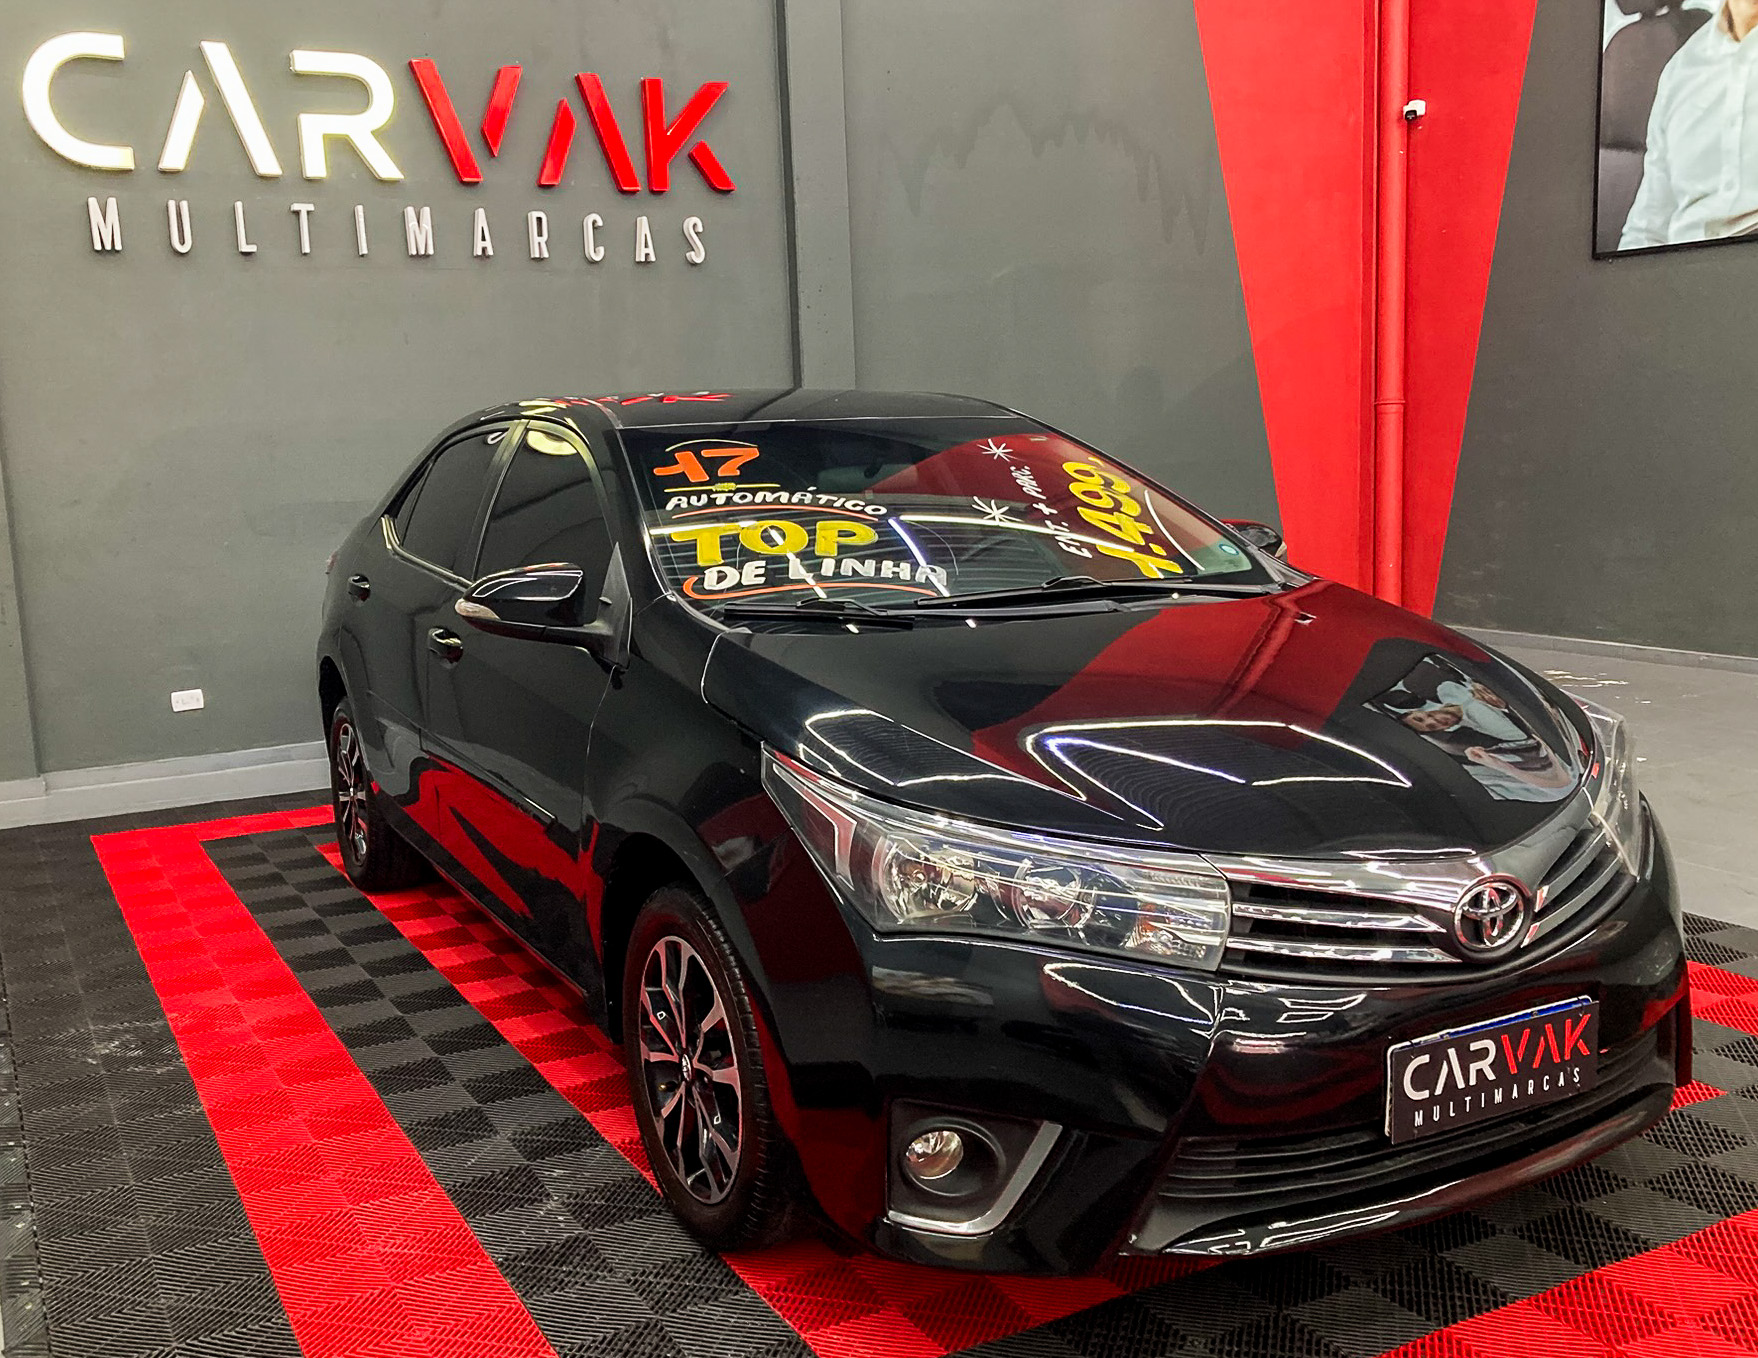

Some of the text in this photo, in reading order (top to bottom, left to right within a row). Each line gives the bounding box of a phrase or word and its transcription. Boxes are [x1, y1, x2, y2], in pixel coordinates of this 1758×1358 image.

[22, 31, 736, 193] CARVAK
[87, 197, 707, 265] MULTIMARCAS
[653, 447, 760, 483] 17
[665, 486, 888, 516] AUTOMÁTICO
[671, 519, 879, 567] TOP
[703, 558, 948, 591] DE LINHA
[1403, 1013, 1592, 1101] CARVAK
[1414, 1067, 1581, 1128] MULTIMARCAS
